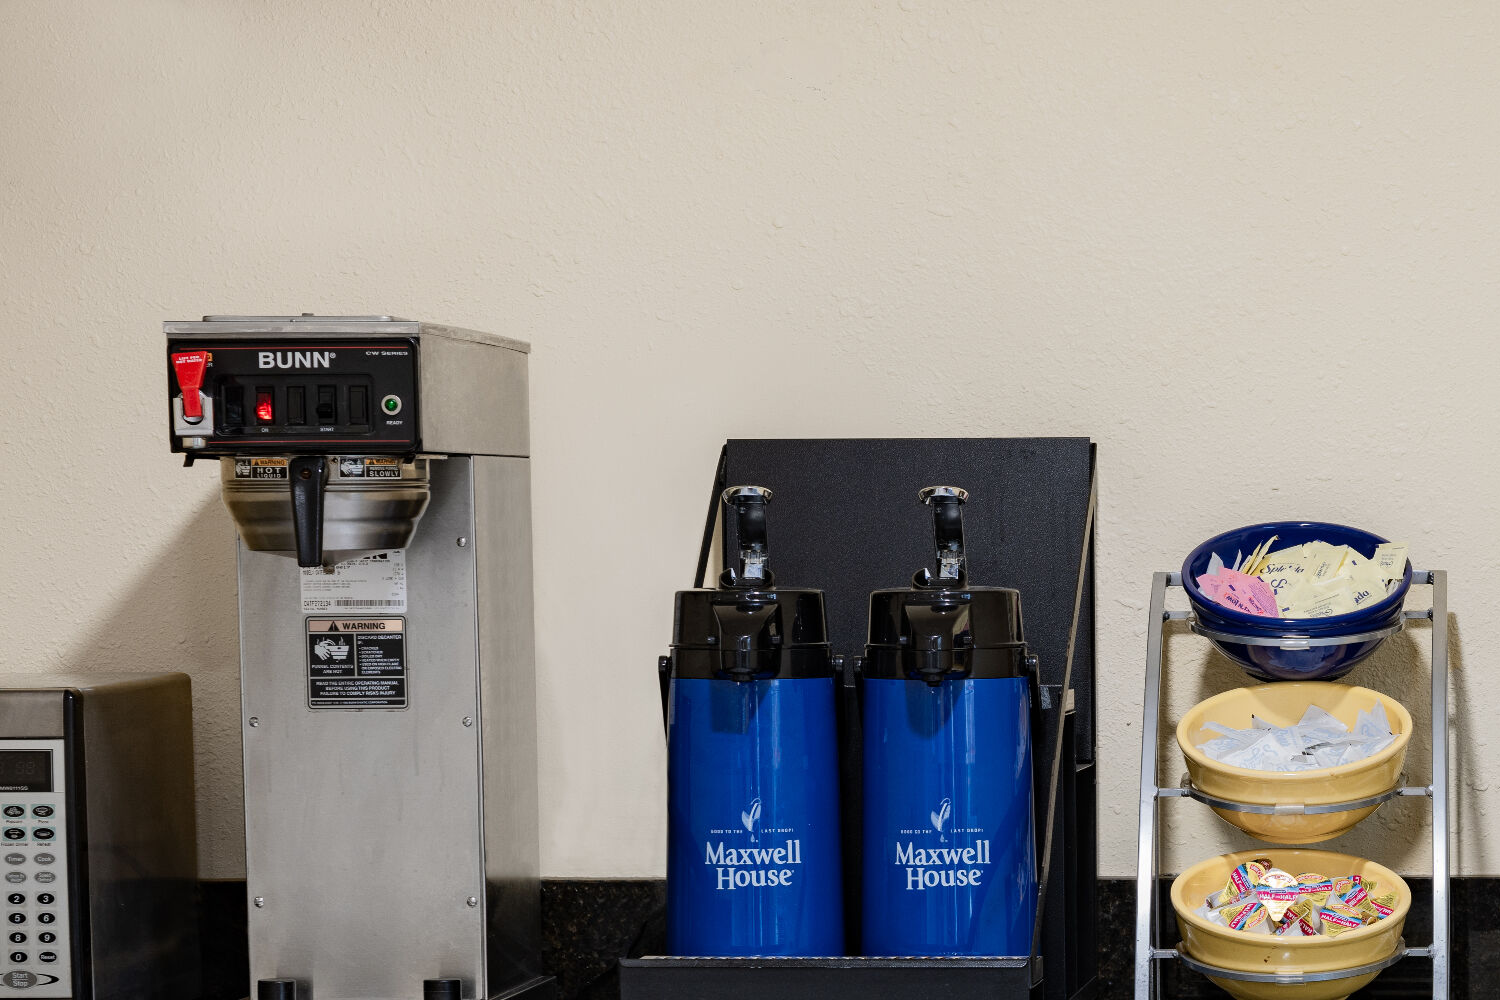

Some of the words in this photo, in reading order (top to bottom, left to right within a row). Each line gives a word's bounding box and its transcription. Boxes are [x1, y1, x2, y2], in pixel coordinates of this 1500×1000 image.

[258, 352, 330, 369] BUNN
[342, 622, 386, 630] WARNING
[704, 840, 802, 866] Maxwell
[894, 840, 991, 866] Maxwell
[716, 868, 792, 890] House
[906, 868, 982, 890] House
